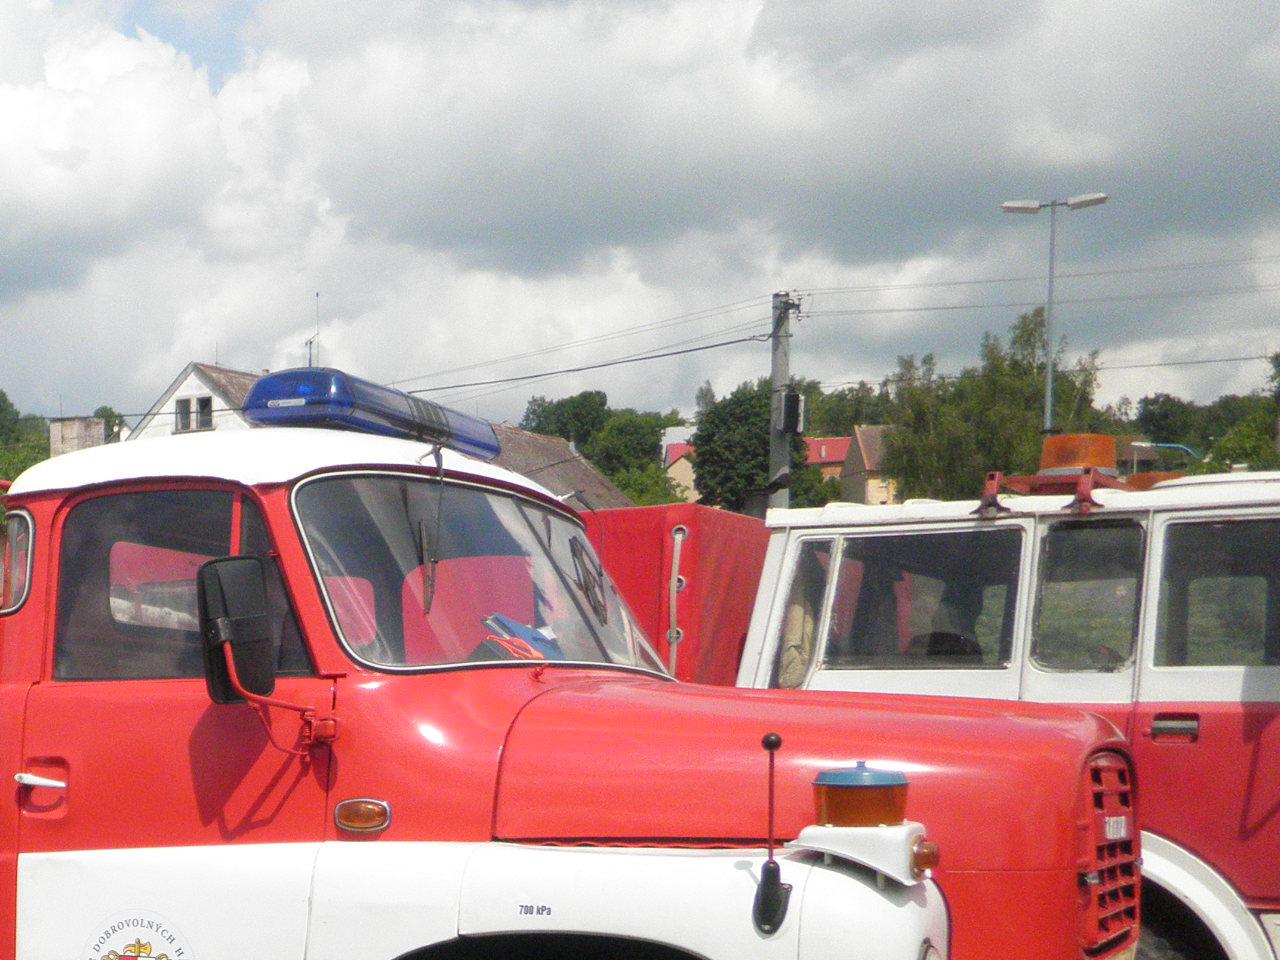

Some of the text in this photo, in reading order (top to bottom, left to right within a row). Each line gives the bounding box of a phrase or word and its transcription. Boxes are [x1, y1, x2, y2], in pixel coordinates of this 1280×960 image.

[519, 904, 552, 916] 700 kPa
[92, 918, 176, 953] DOBROVOLNÝCH
